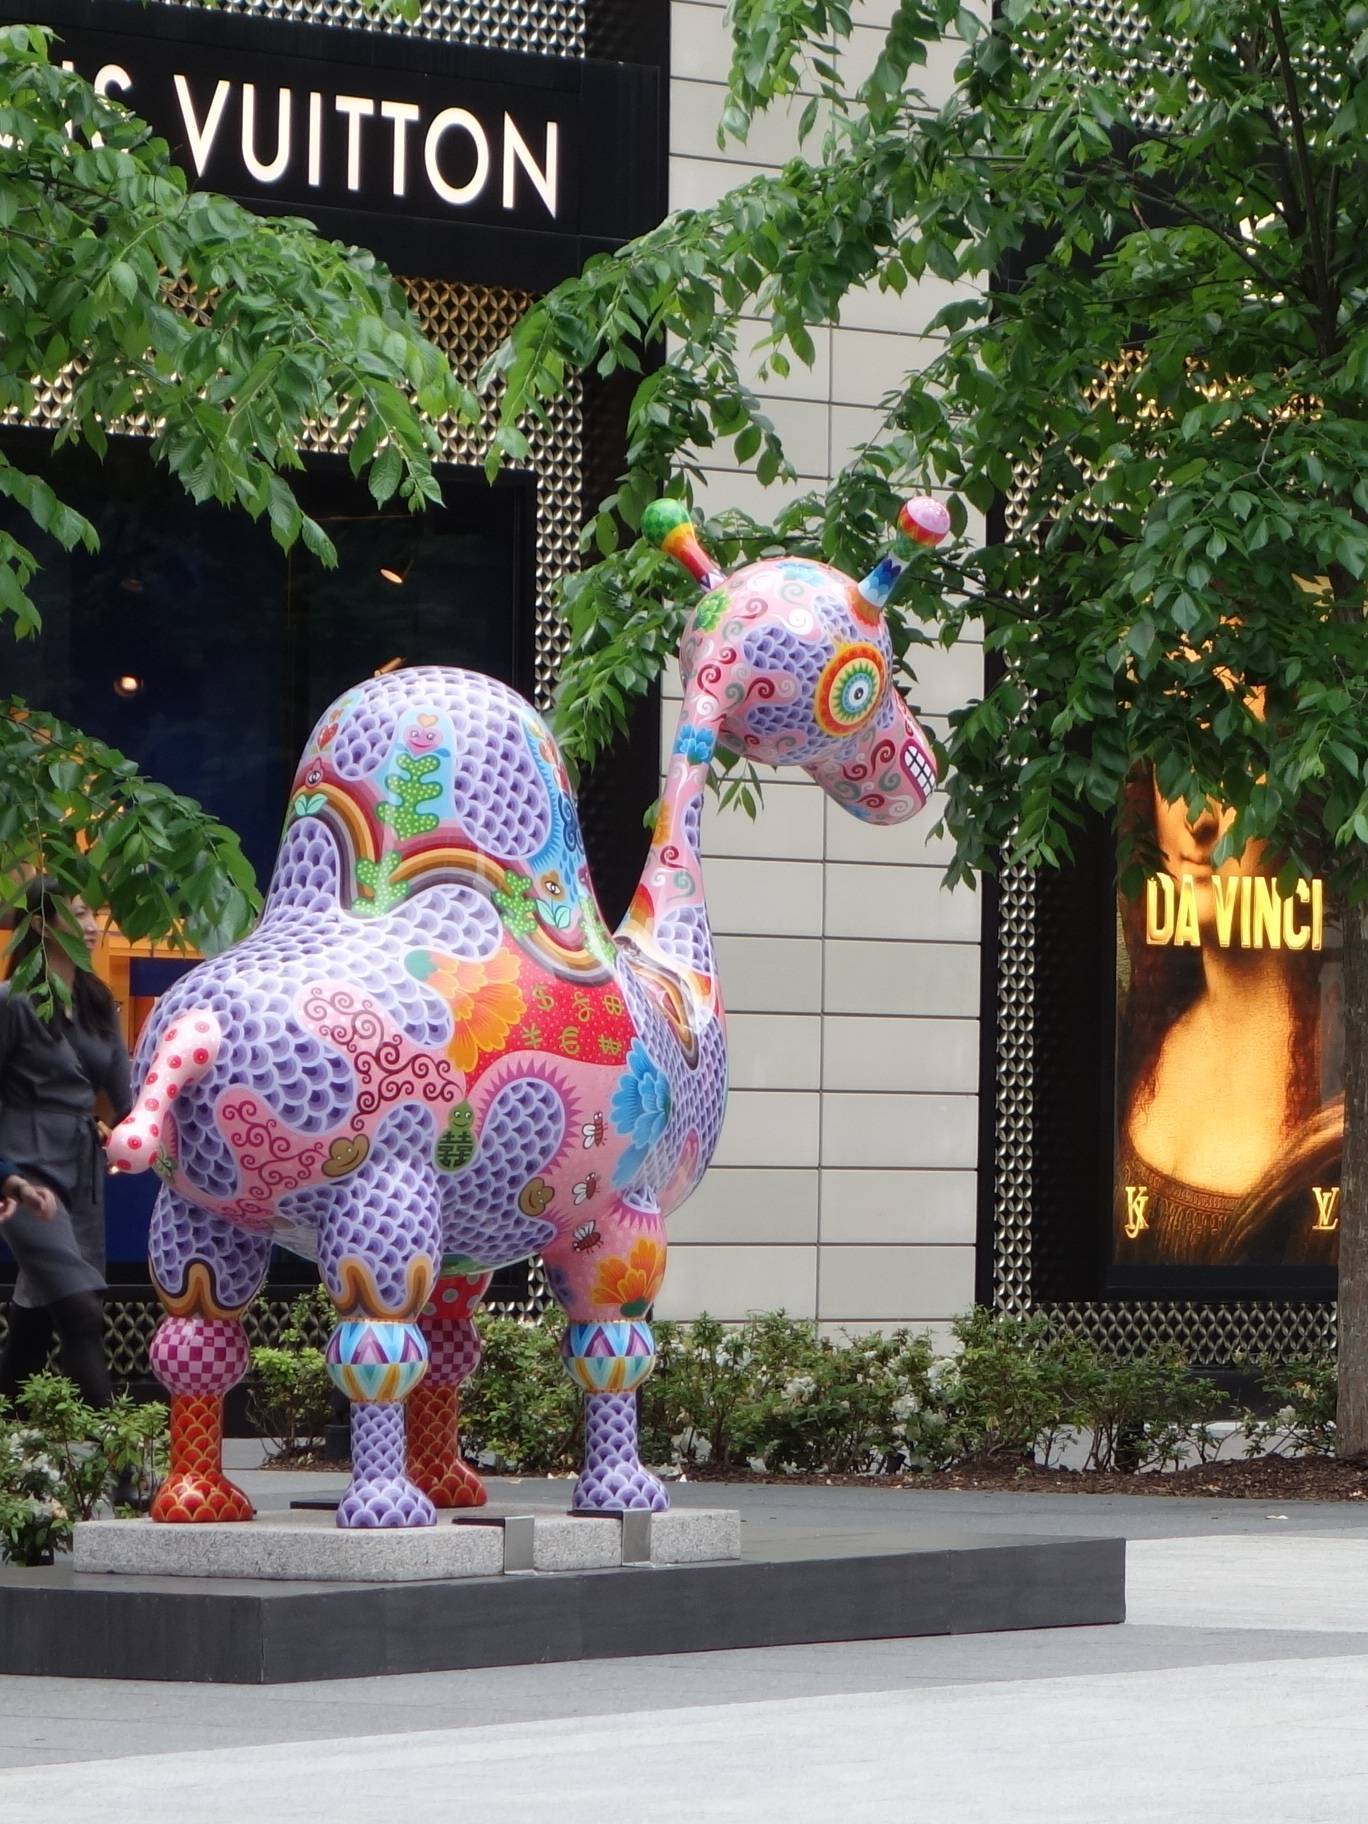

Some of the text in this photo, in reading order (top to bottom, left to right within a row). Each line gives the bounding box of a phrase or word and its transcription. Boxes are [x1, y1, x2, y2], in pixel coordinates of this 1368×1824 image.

[173, 74, 559, 219] VUITTON
[1146, 871, 1323, 950] DA VINCI
